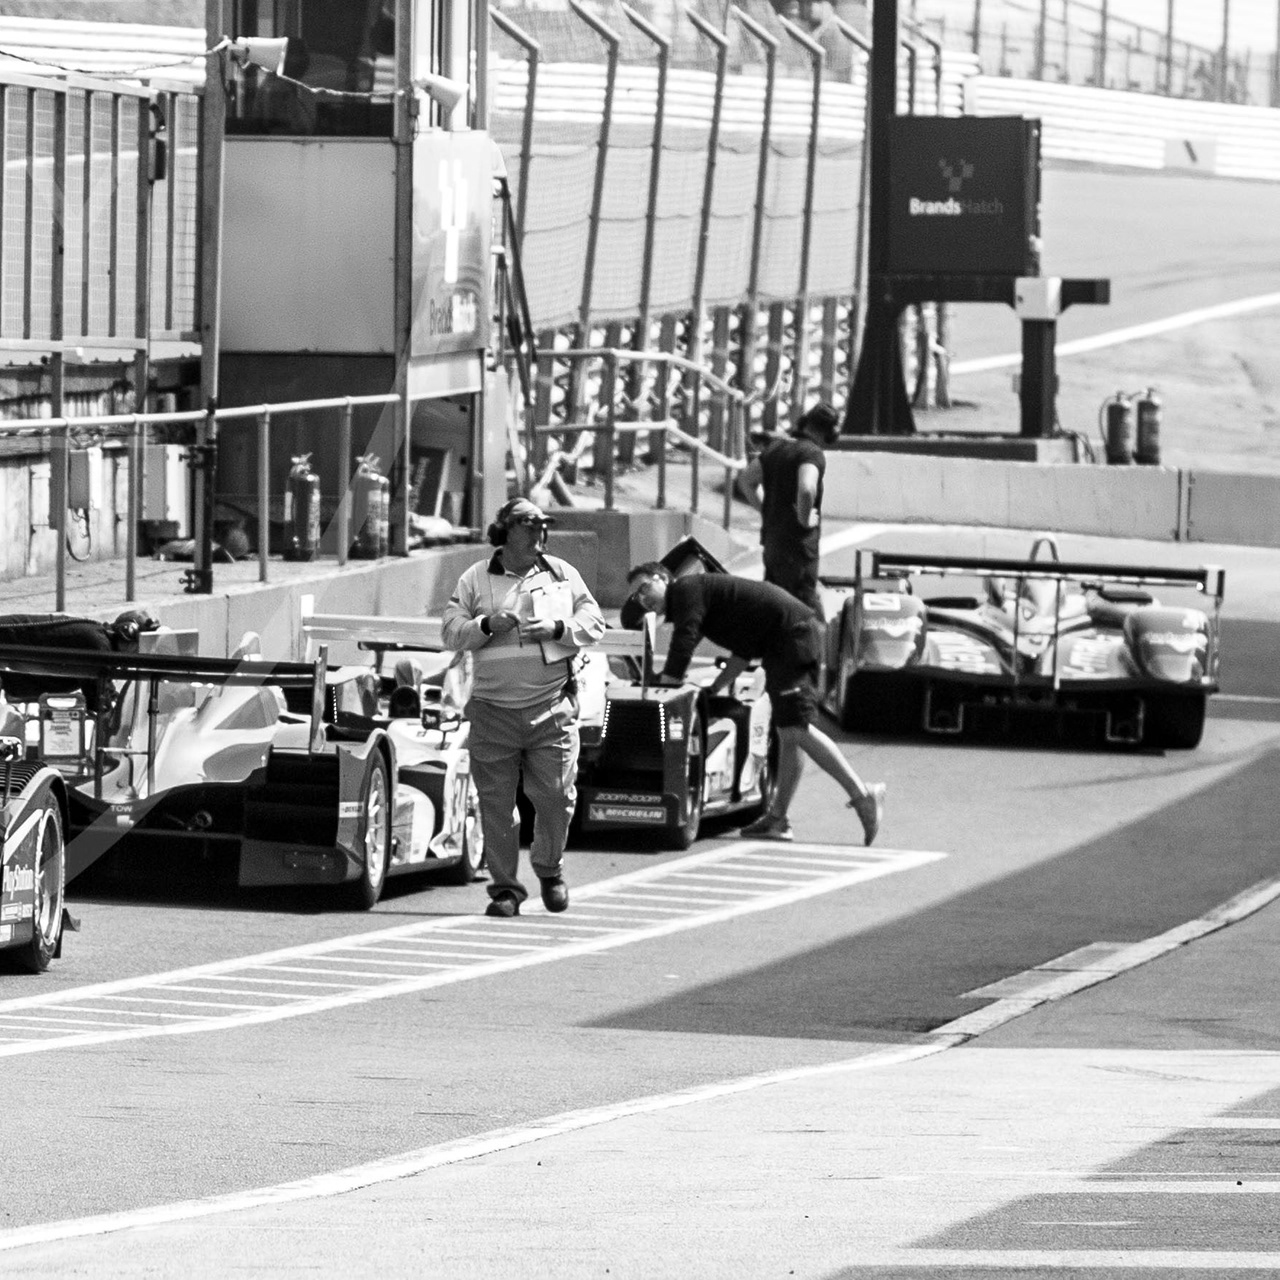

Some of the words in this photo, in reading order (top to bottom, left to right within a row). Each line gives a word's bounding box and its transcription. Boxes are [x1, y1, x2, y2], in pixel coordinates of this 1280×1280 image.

[909, 197, 1004, 216] BrandsHatch
[110, 804, 132, 812] TOW
[606, 808, 663, 819] MICHELIN
